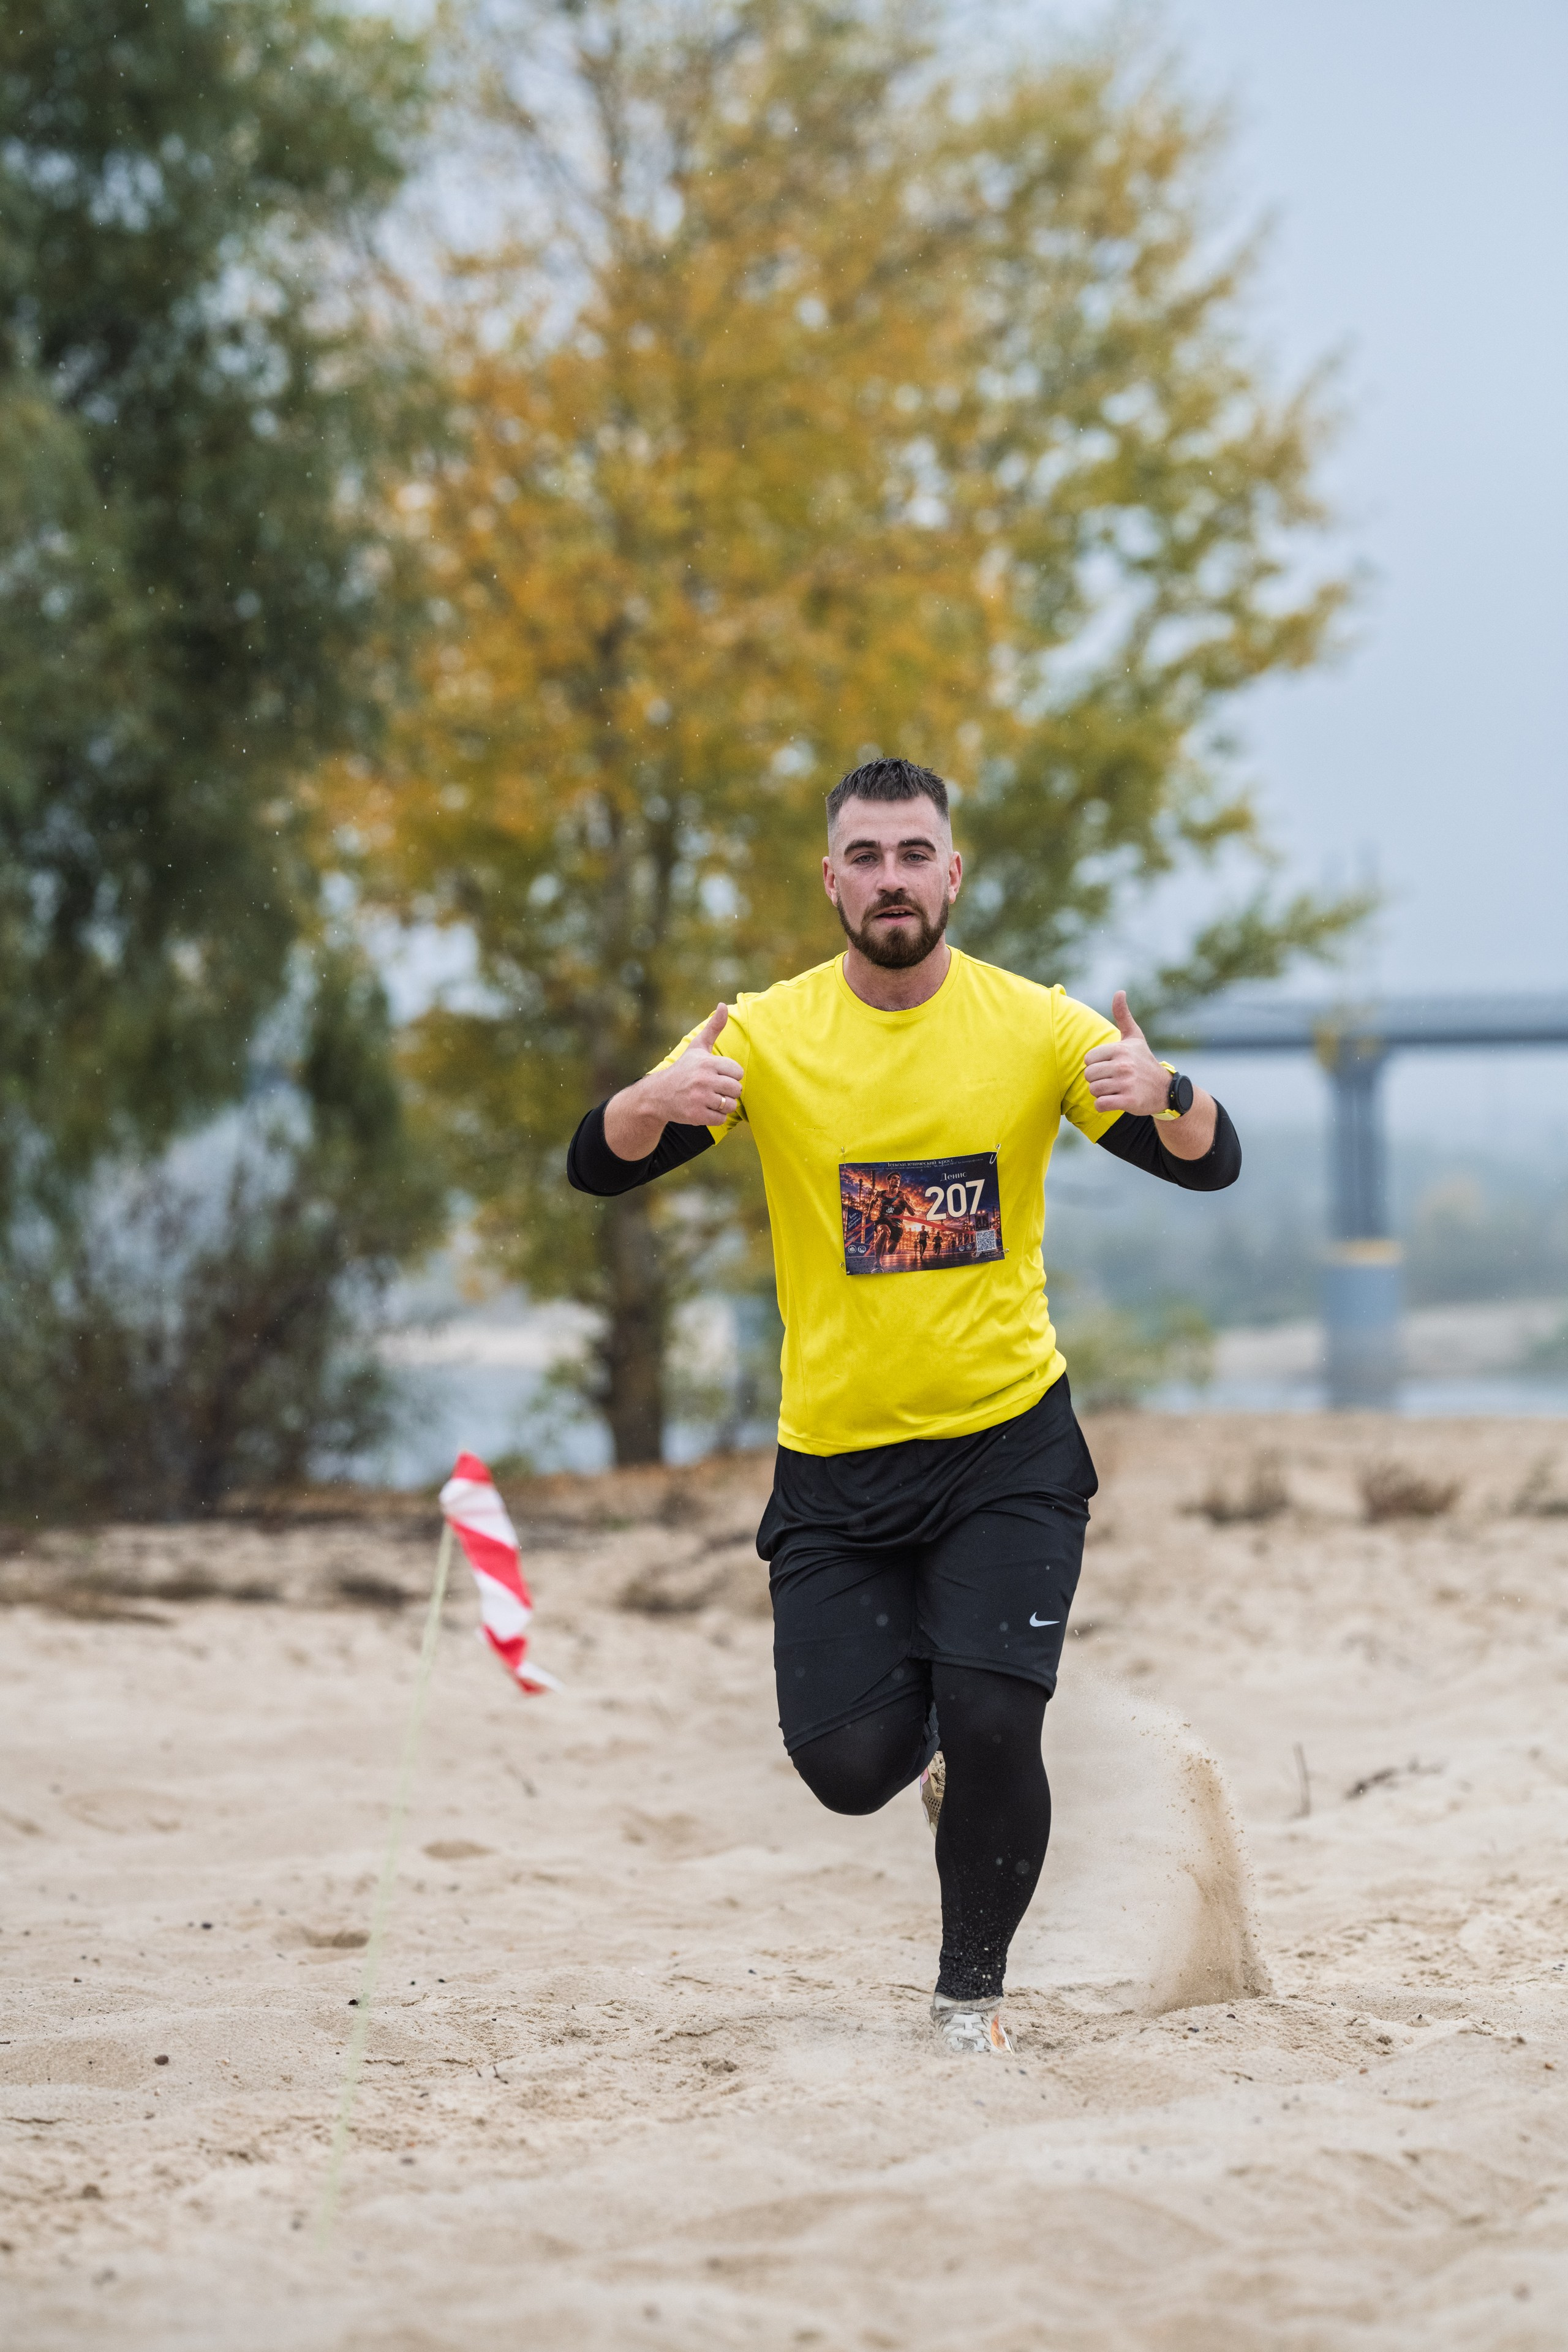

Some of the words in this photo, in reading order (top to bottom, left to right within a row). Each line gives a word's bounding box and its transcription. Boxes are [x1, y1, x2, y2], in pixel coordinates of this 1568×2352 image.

[938, 1159, 954, 1167] кросс
[940, 1171, 967, 1182] Денис
[924, 1178, 986, 1221] 207
